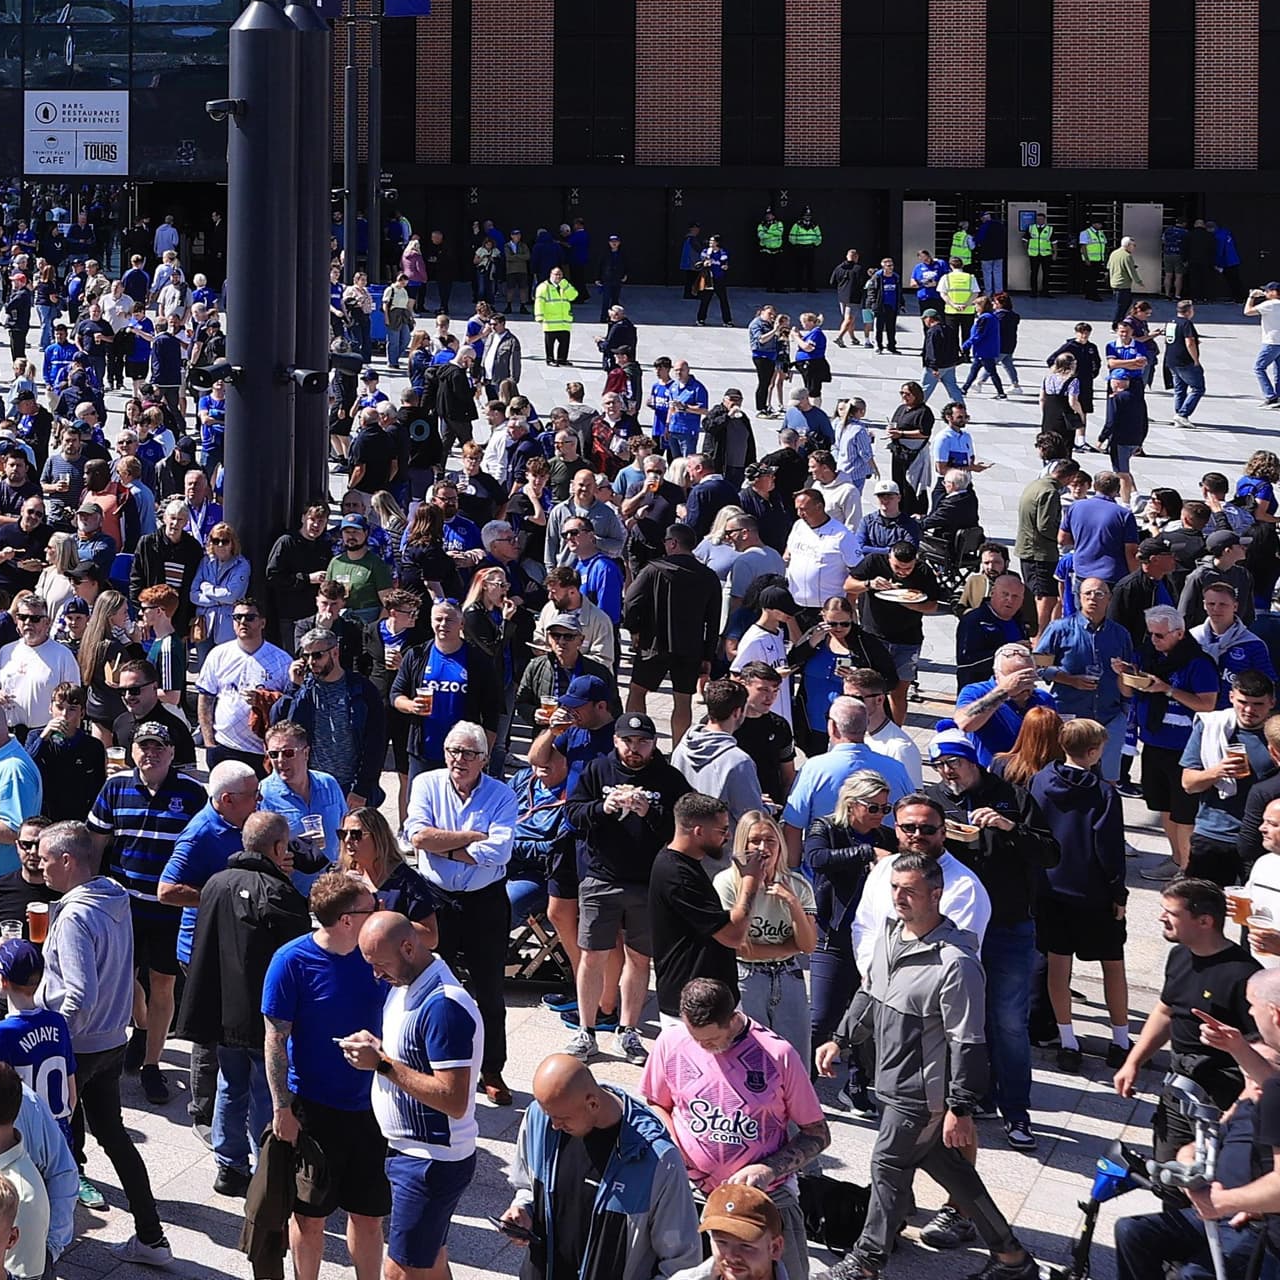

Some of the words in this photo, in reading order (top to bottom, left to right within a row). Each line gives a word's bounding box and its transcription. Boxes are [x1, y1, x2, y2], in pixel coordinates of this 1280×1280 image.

[38, 156, 65, 164] CAFE
[83, 144, 118, 162] TOURS
[1019, 142, 1040, 167] 19
[749, 917, 793, 938] Stake
[18, 1026, 60, 1053] NDIAYE
[689, 1100, 758, 1137] Stake
[710, 1131, 741, 1144] .com
